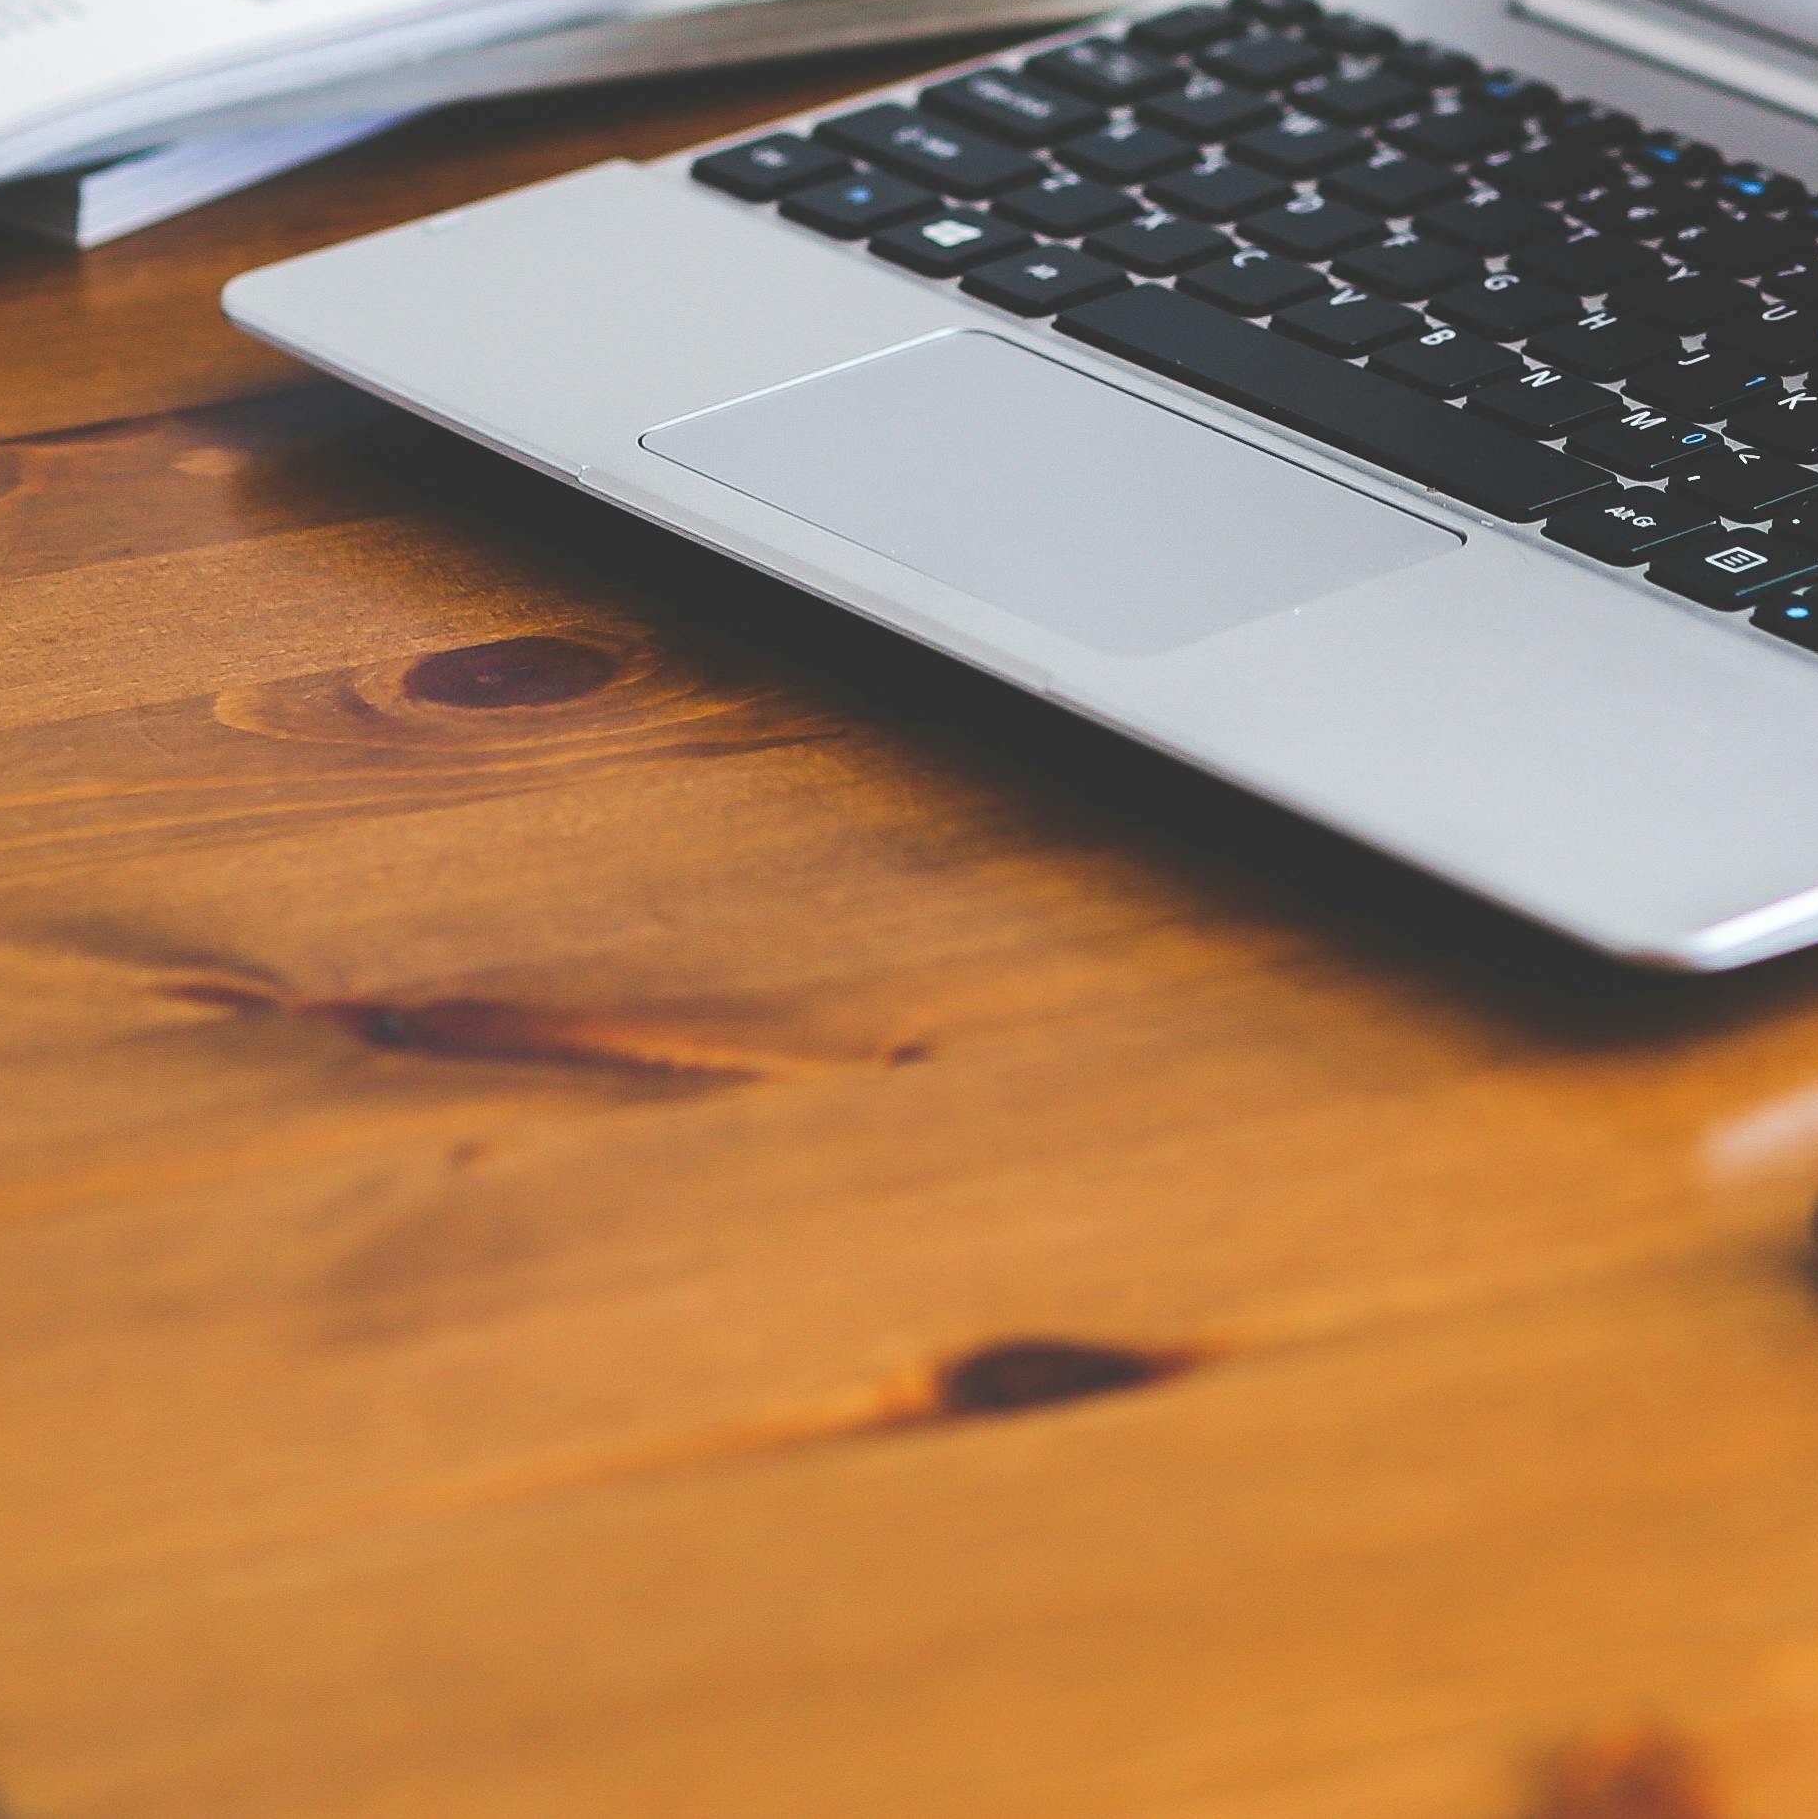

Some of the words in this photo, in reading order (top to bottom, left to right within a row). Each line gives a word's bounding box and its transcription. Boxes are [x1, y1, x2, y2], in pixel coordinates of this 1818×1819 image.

[1232, 249, 1269, 268] C
[1484, 275, 1519, 290] G
[1330, 287, 1366, 305] V
[1762, 303, 1797, 320] U
[1579, 313, 1617, 330] H
[1420, 326, 1456, 345] B
[1678, 354, 1710, 365] J
[1521, 369, 1561, 387] N
[1746, 377, 1766, 386] 1
[1778, 391, 1817, 409] K
[1621, 409, 1666, 430] M
[1682, 434, 1706, 444] 0
[1605, 507, 1636, 521] Alt
[1632, 516, 1656, 528] Gr
